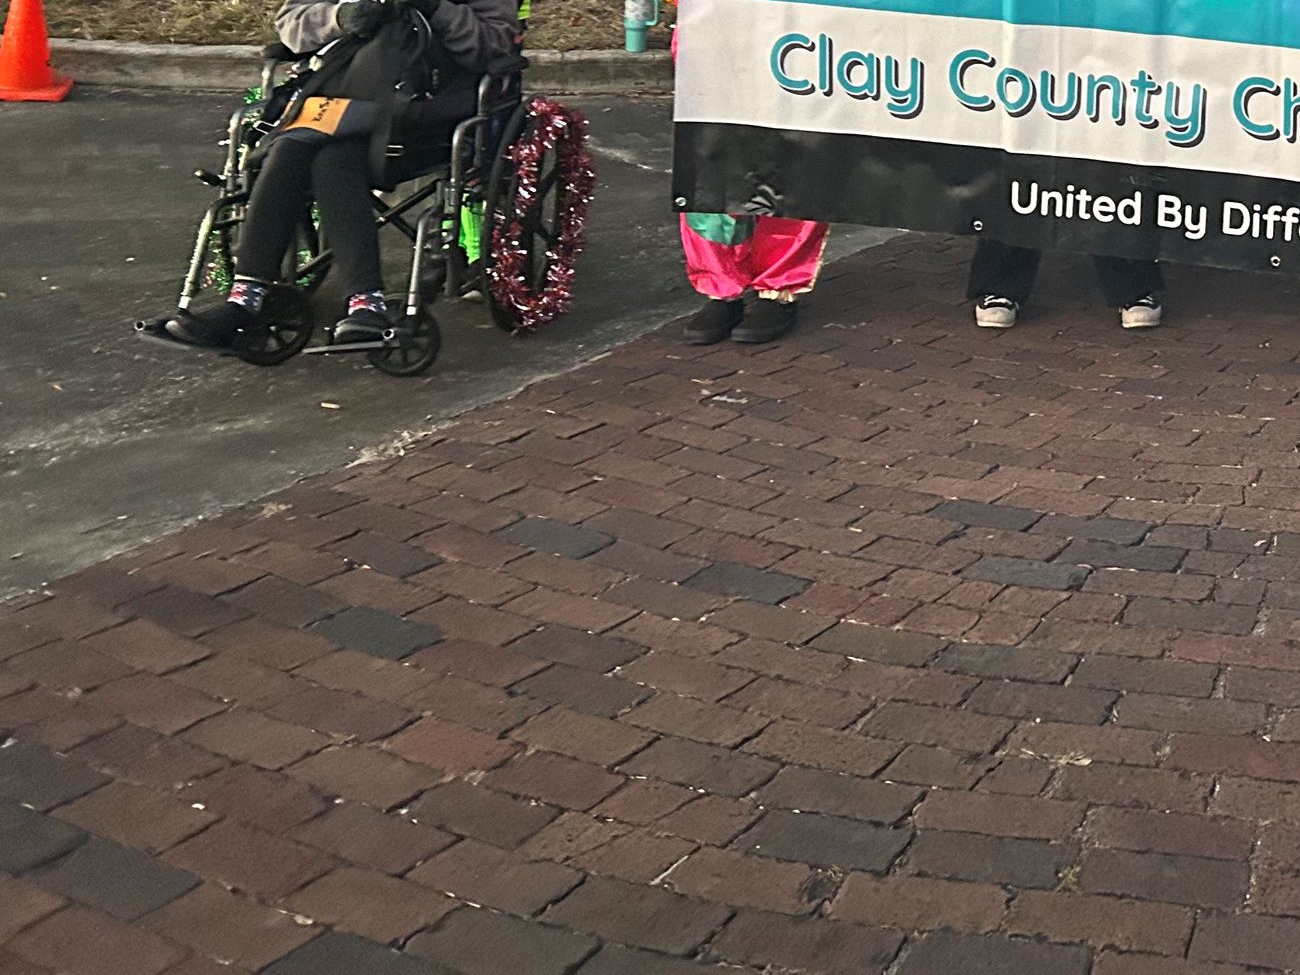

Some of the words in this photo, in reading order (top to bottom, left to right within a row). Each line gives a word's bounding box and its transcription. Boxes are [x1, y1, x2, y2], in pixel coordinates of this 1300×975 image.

[770, 33, 924, 119] Clay
[949, 49, 1207, 148] County
[1010, 180, 1142, 227] United
[1157, 194, 1208, 241] By
